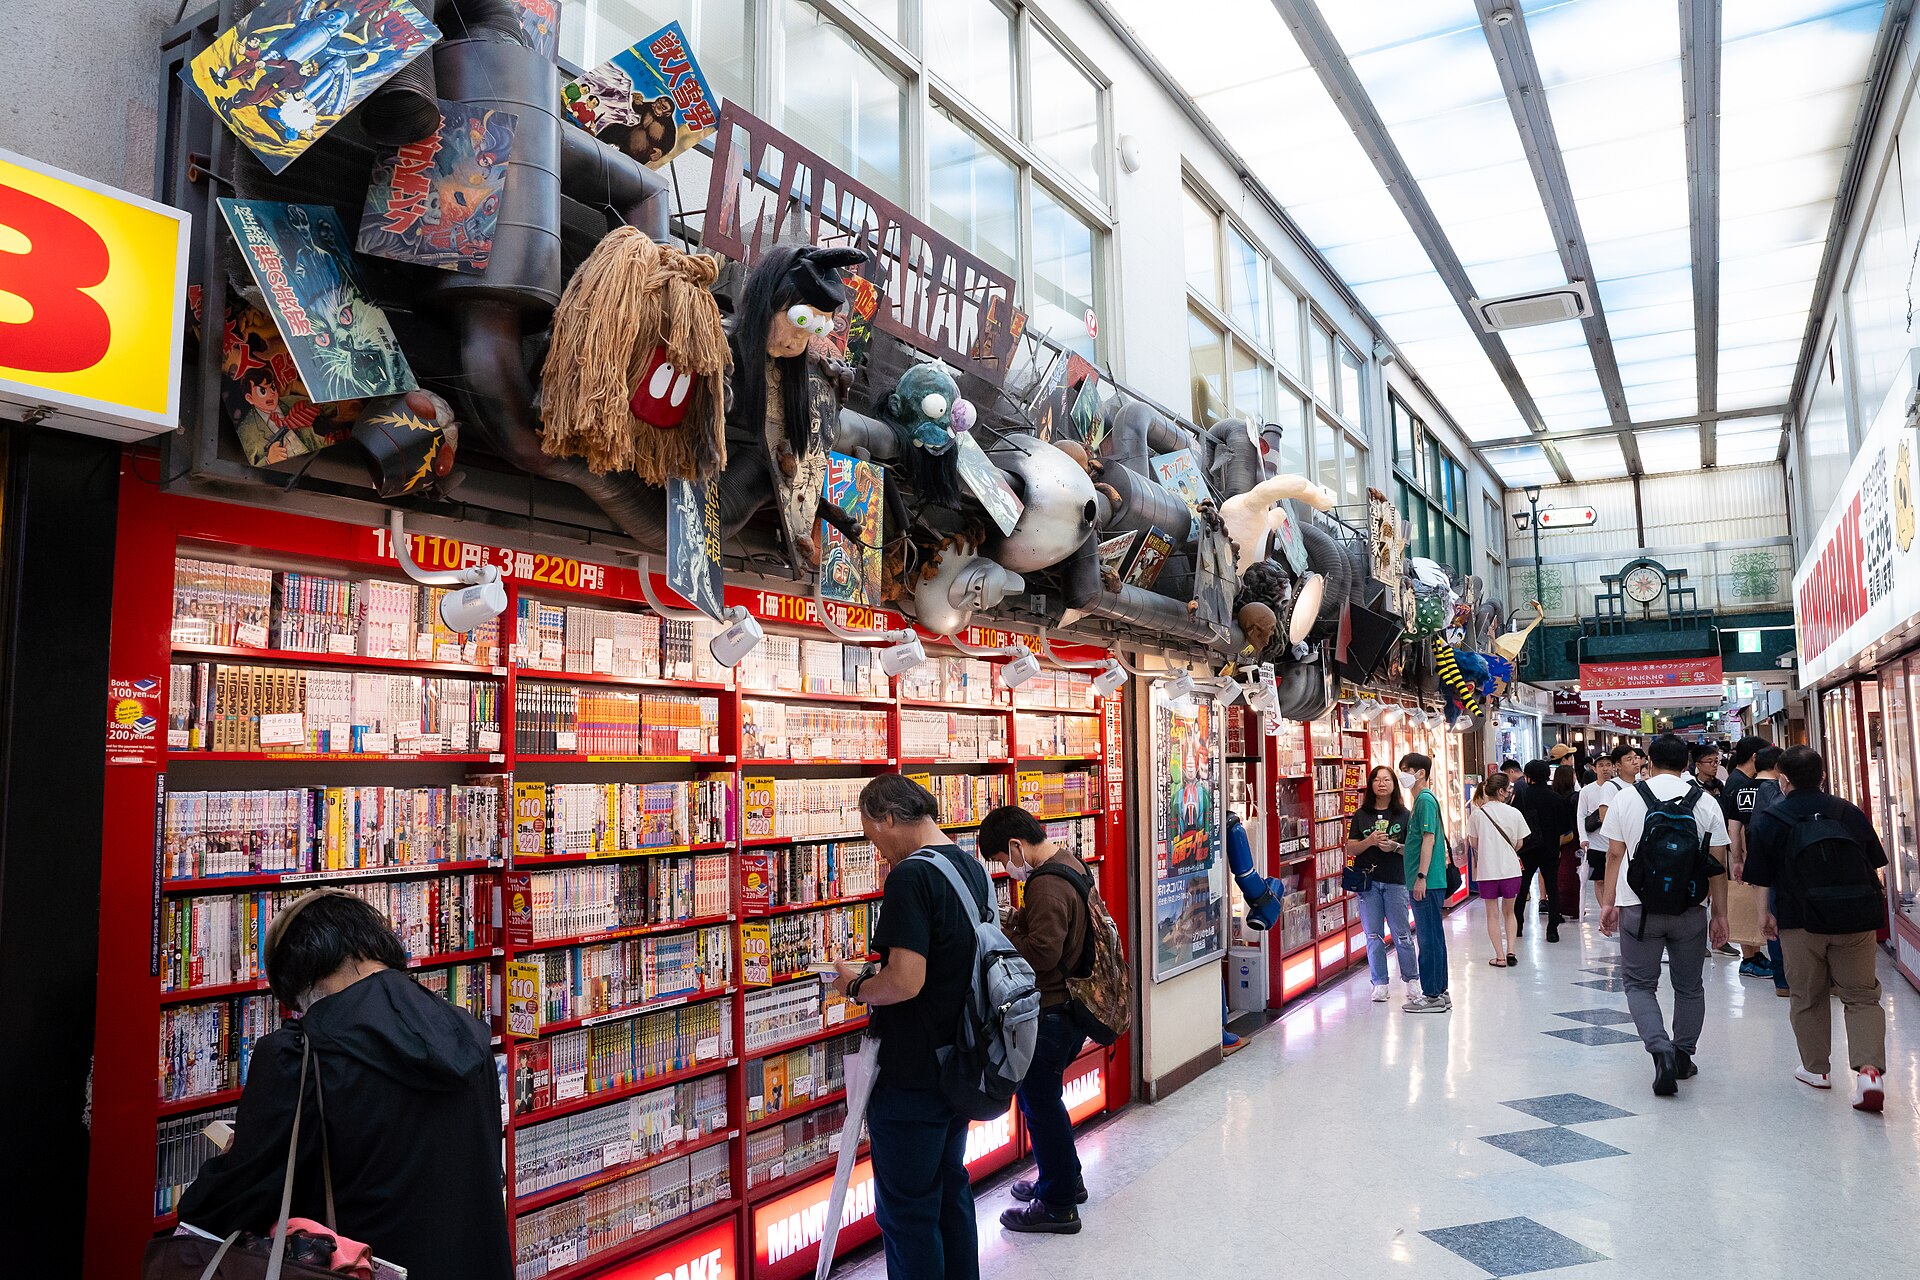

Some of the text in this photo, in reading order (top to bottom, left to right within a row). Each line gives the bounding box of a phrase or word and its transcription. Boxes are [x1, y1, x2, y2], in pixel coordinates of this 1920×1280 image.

[250, 245, 318, 337] 猫の喪服
[1866, 510, 1892, 573] どこよりも
[1799, 488, 1869, 667] MANDARAKE
[1868, 554, 1895, 610] 高く買います!
[111, 679, 130, 687] Book
[113, 687, 131, 697] 100
[1627, 674, 1664, 682] NAKANO
[109, 730, 129, 740] 200
[1228, 705, 1240, 754] 営業時間
[281, 873, 319, 882] まんだらけ営業時間
